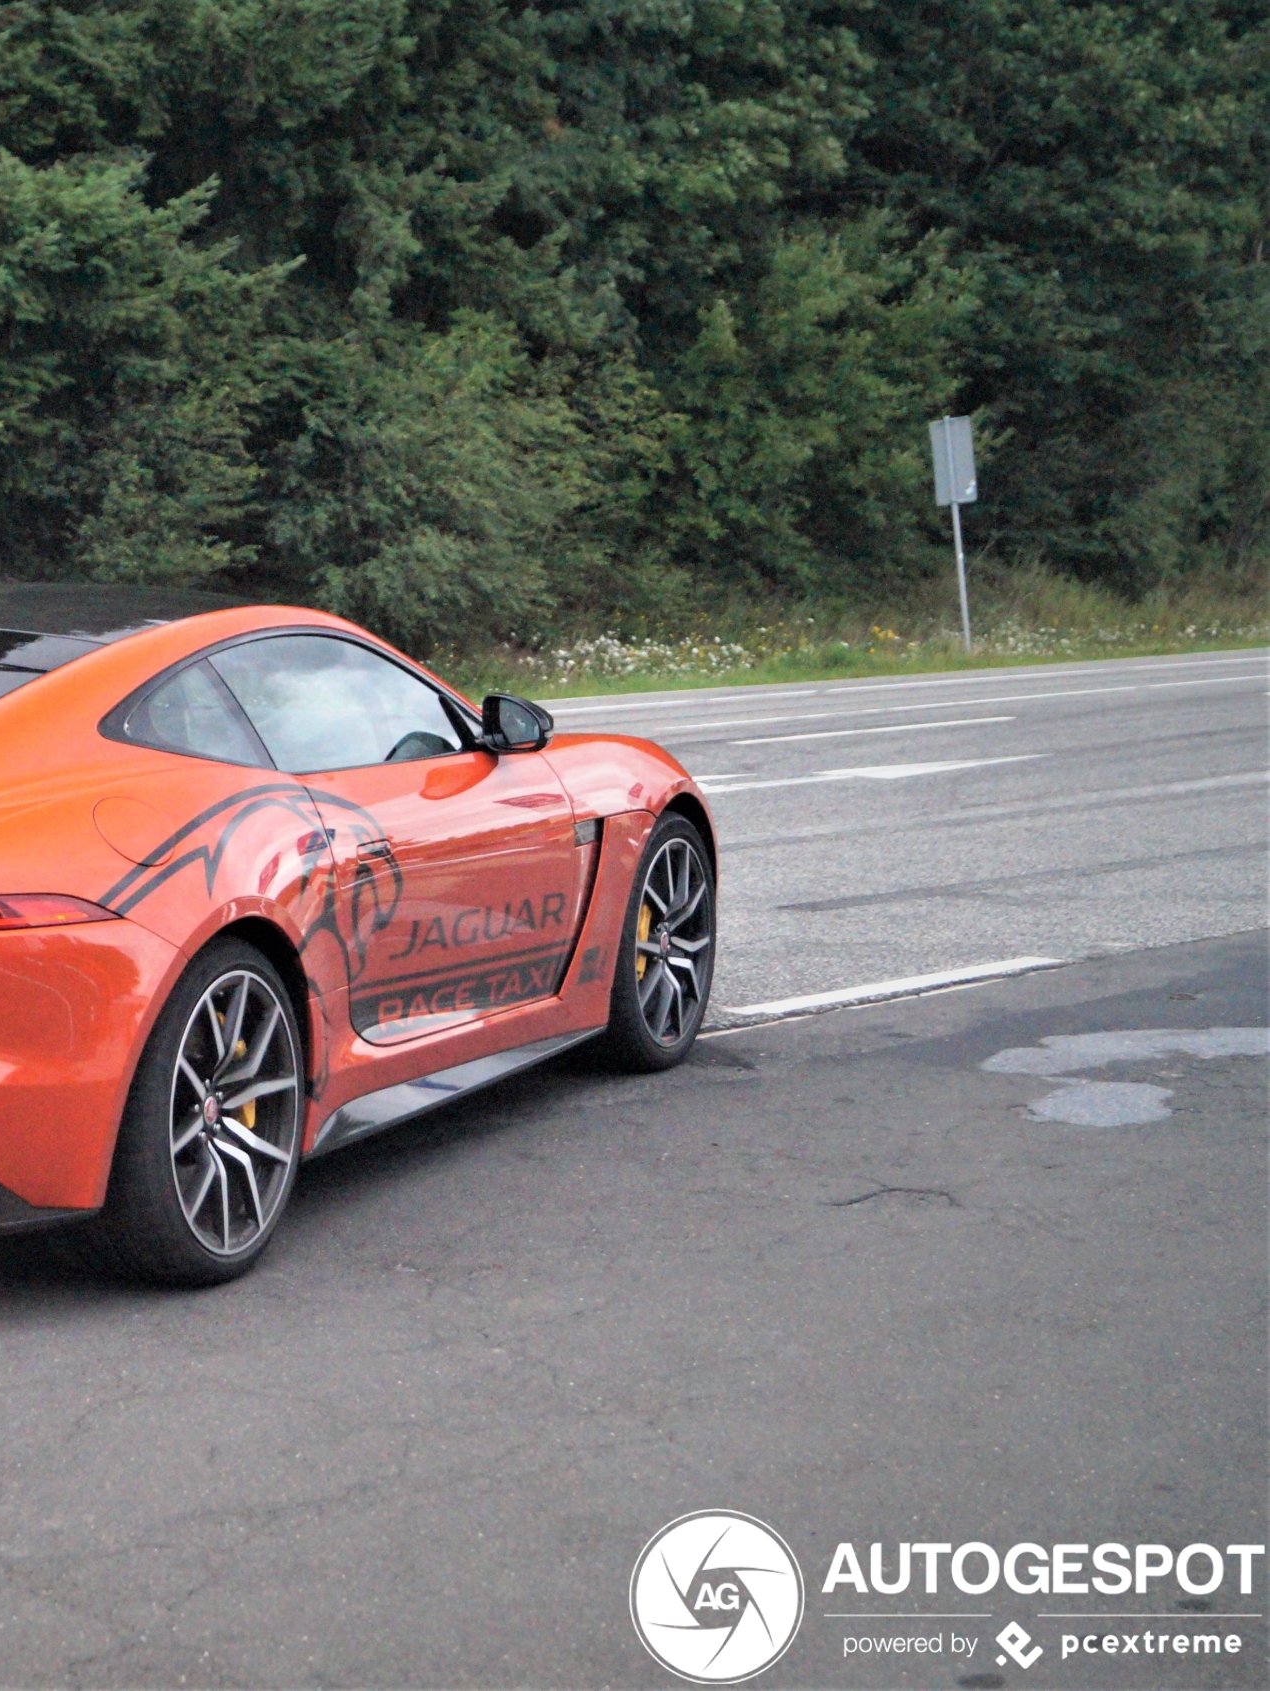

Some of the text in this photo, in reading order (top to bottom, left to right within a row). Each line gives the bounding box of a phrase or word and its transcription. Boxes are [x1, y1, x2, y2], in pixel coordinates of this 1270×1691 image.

[388, 891, 567, 961] JAGUAR
[377, 962, 557, 1032] RACE TAXI
